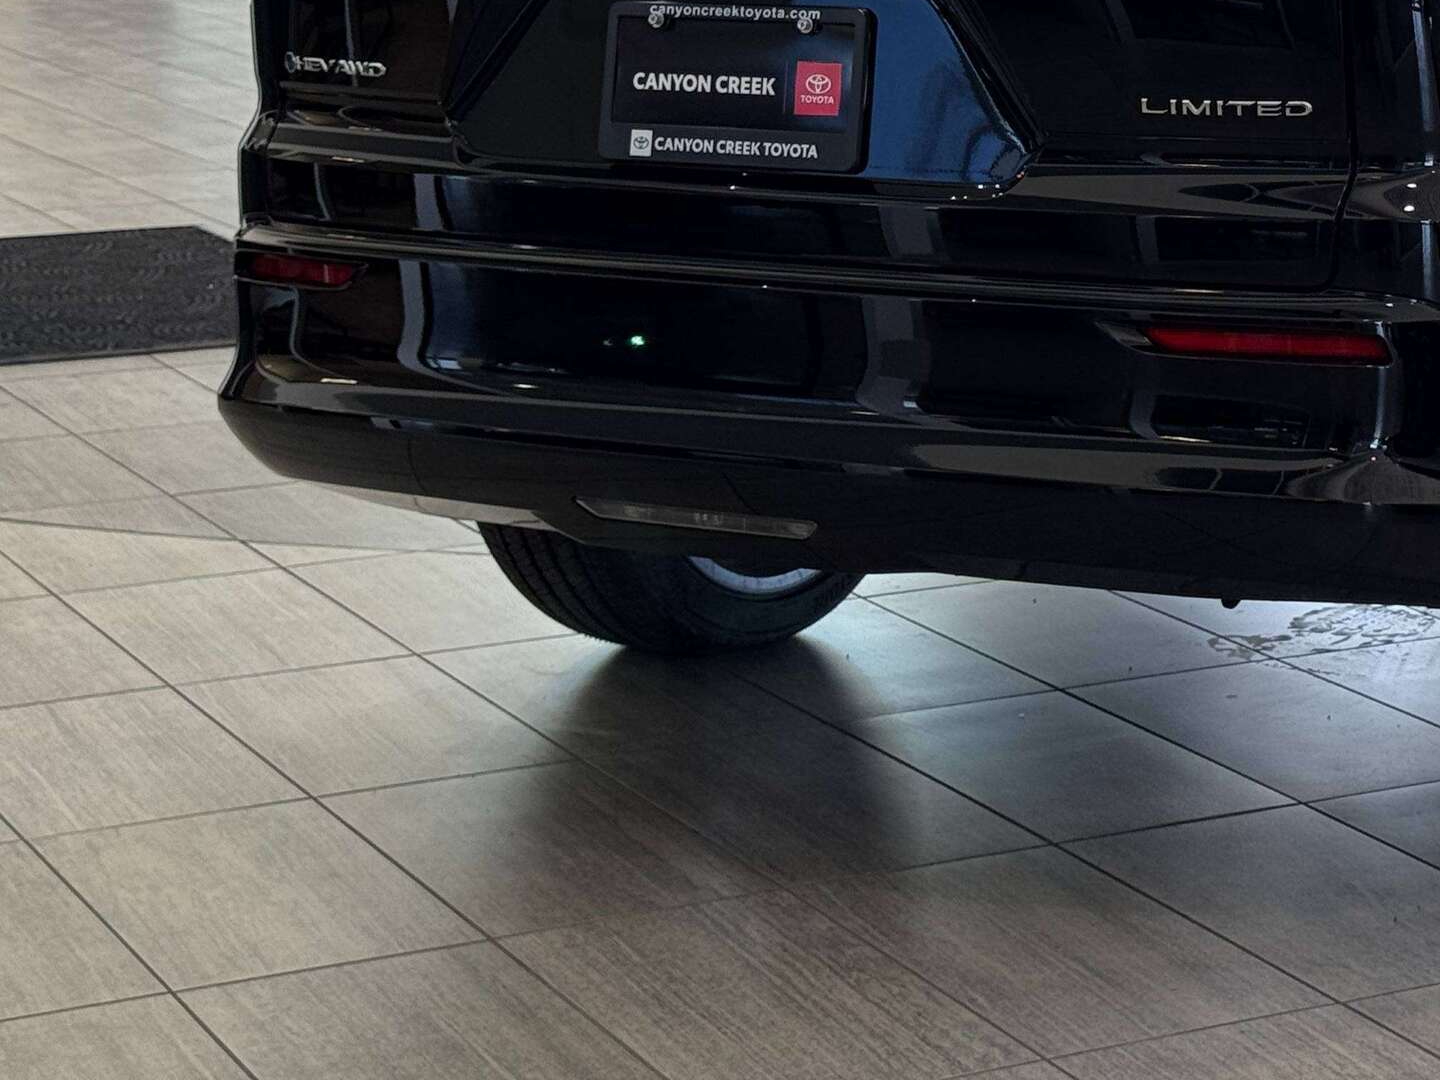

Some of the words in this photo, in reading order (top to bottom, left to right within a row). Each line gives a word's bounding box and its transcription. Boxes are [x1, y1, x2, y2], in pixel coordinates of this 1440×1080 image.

[649, 4, 821, 21] canyoncreektoyota.com
[632, 71, 712, 93] CANYON
[715, 75, 777, 96] CREEK
[800, 94, 835, 106] TOYOTA
[1140, 97, 1313, 117] LIMITED
[654, 136, 714, 154] CANYON
[716, 140, 761, 156] CREEK
[763, 142, 818, 159] TOYOTA
